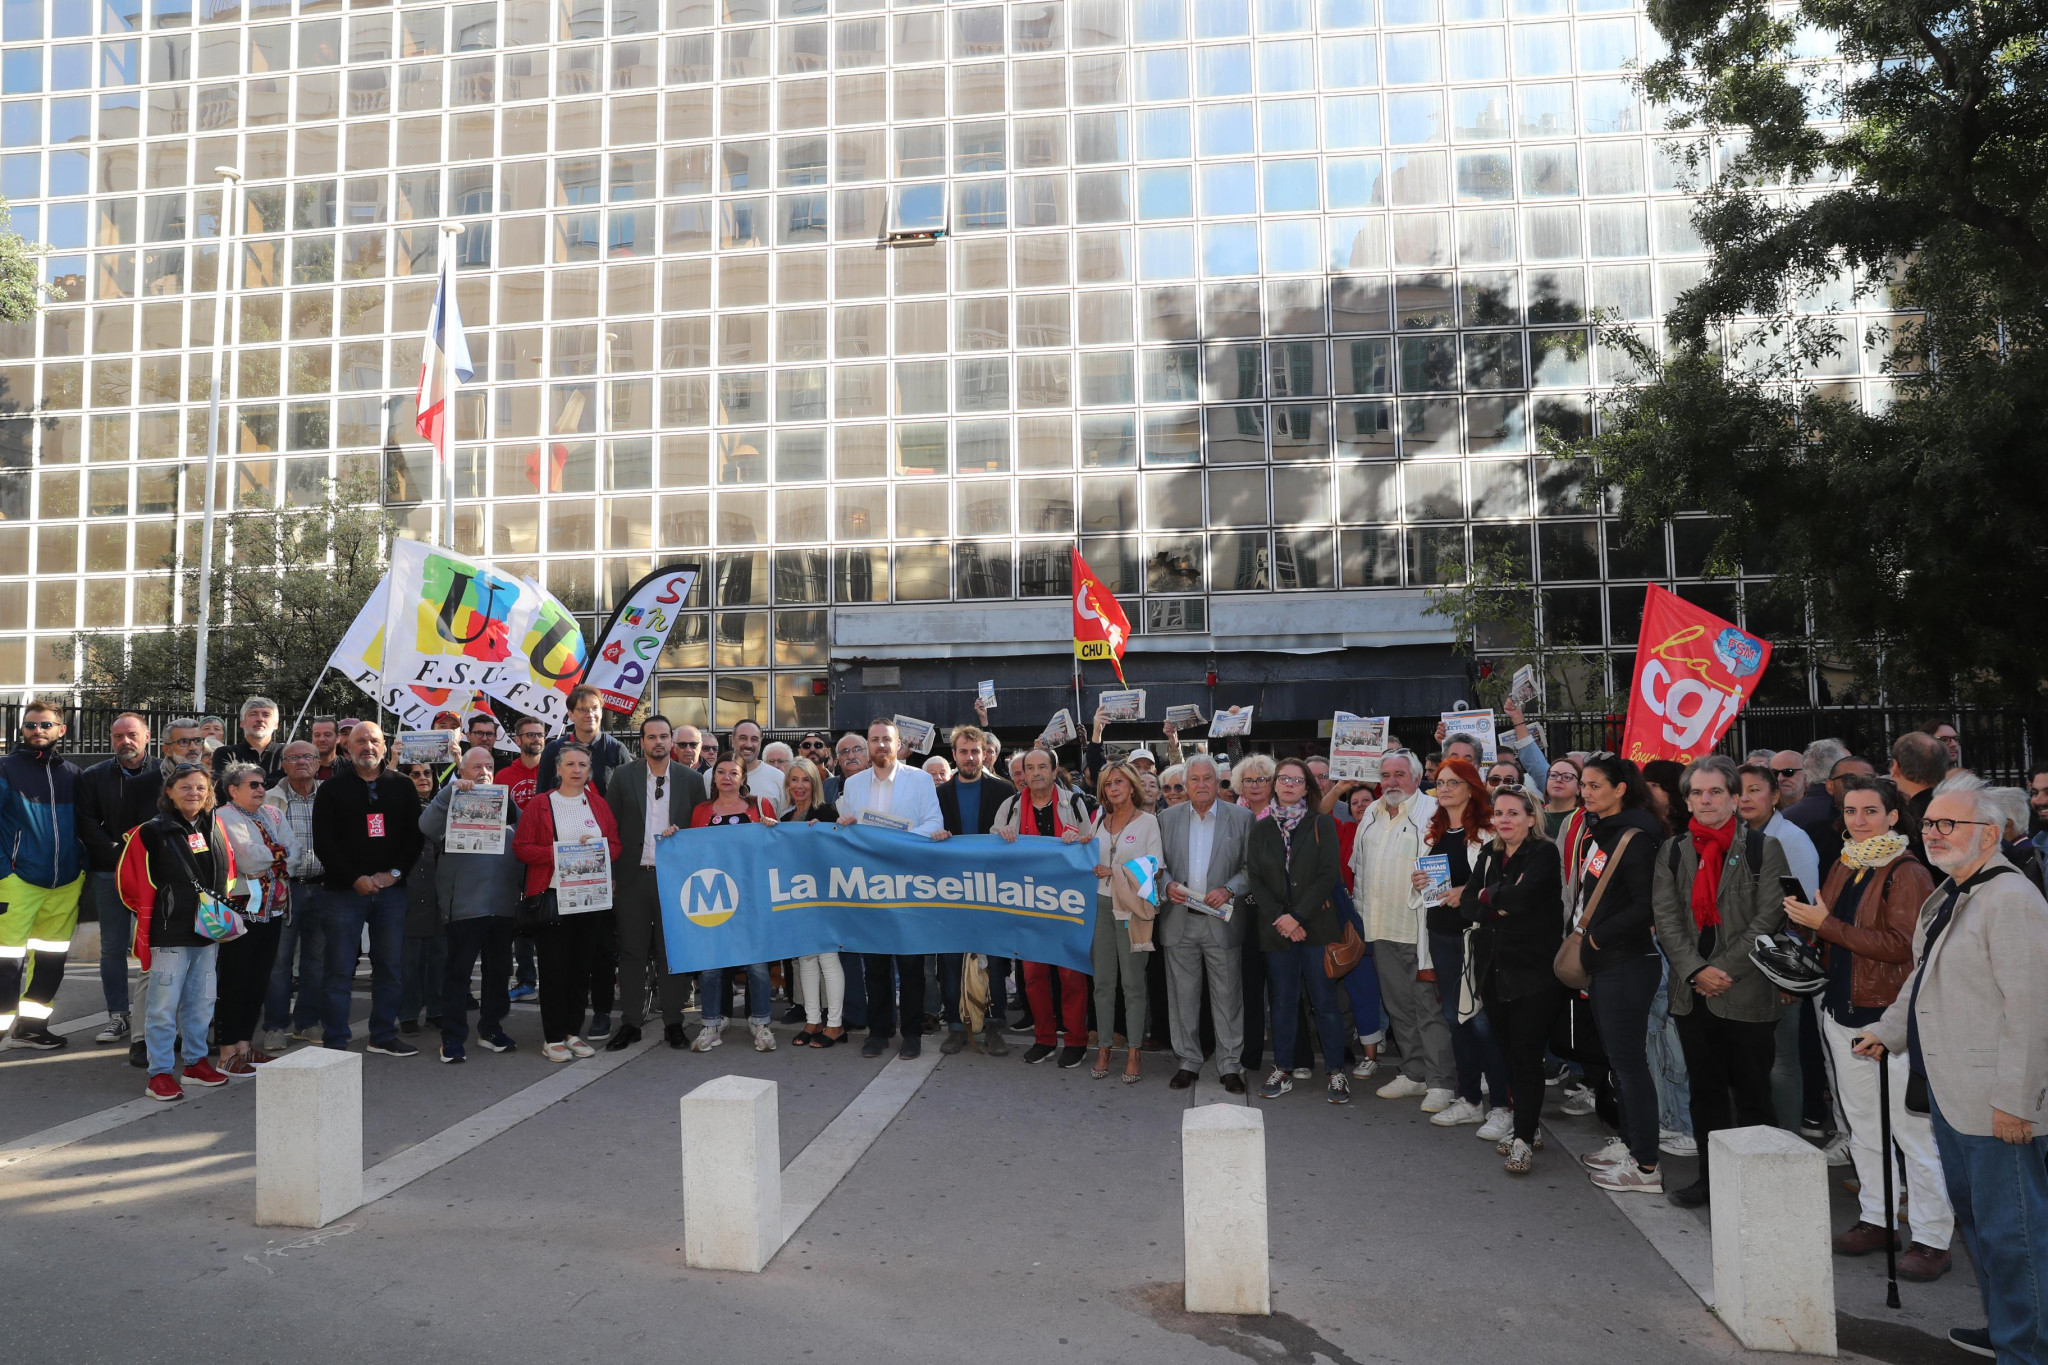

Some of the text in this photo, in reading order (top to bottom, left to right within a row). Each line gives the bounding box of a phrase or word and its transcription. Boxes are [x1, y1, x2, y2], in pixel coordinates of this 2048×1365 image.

[1081, 643, 1103, 657] CHU
[1727, 638, 1756, 660] FSM
[413, 660, 508, 685] F.S.U.
[1640, 658, 1743, 750] cgt
[768, 866, 1087, 915] La Marseillaise
